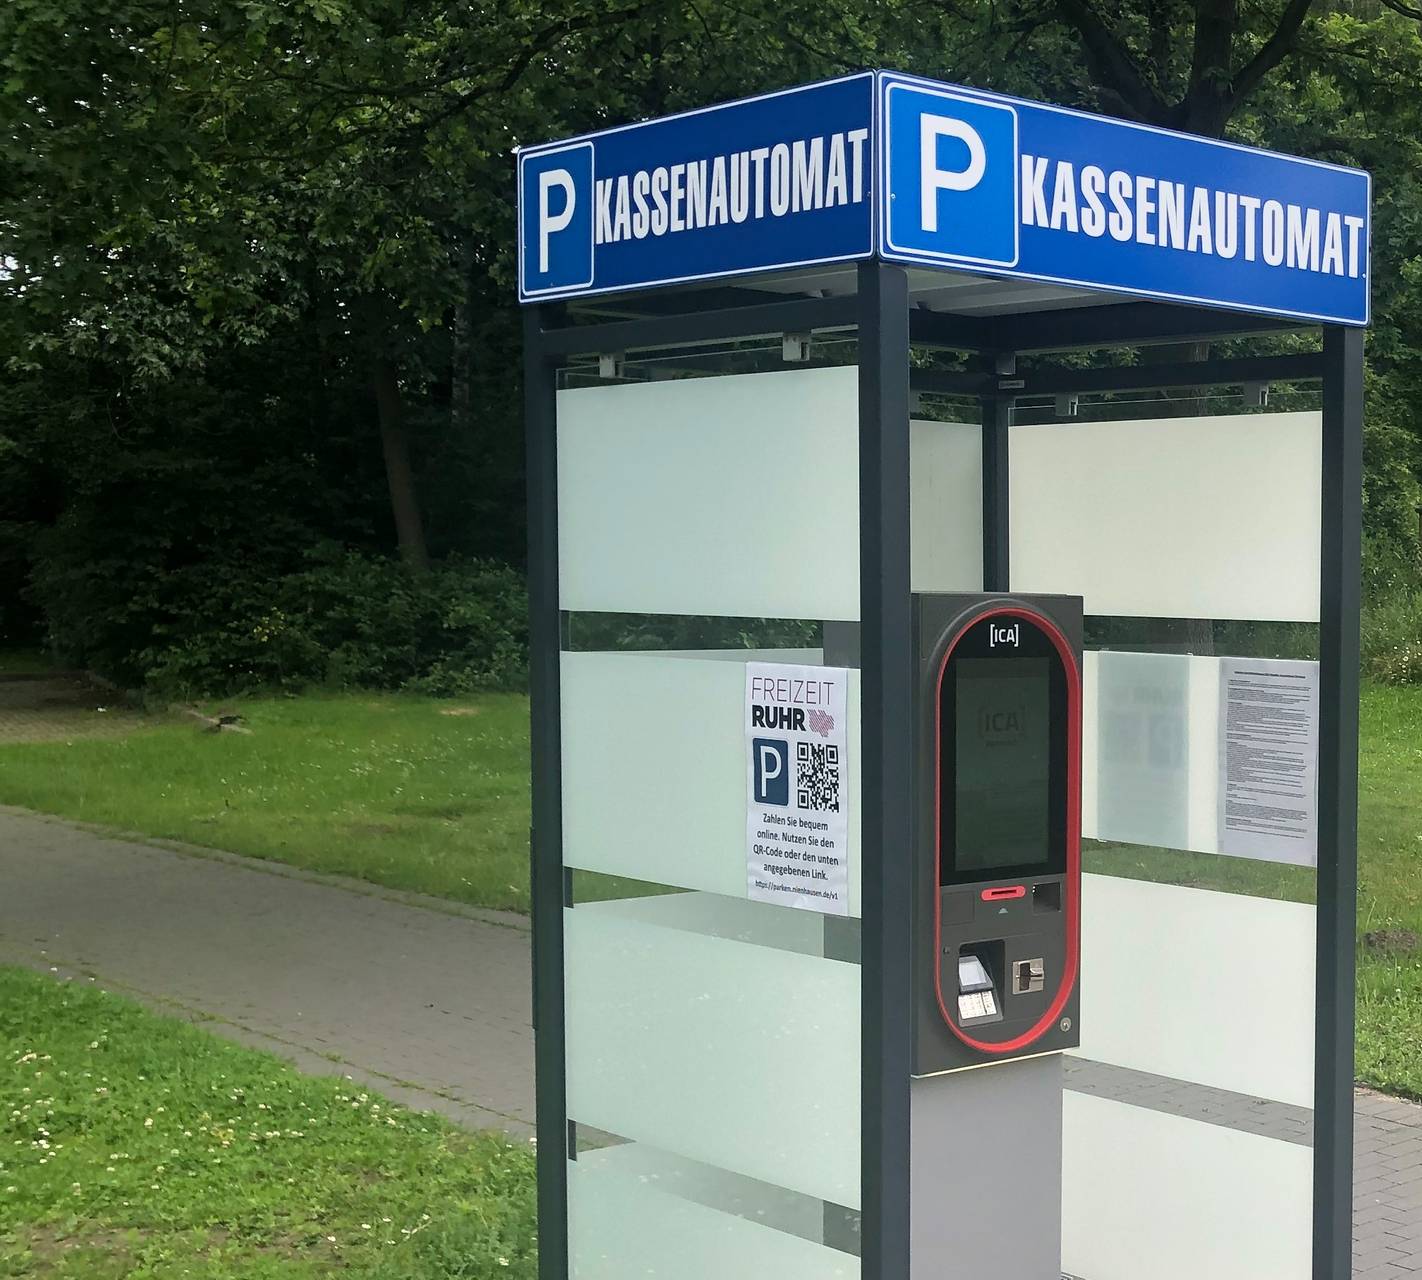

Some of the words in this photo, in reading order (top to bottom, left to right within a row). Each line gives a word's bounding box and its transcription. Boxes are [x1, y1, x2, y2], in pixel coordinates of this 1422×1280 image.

[594, 128, 868, 245] KASSENAUTOMAT
[920, 112, 986, 233] P
[538, 168, 576, 274] P
[1021, 156, 1364, 279] KASSENAUTOMAT
[751, 677, 835, 705] FREIZEIT
[752, 704, 807, 732] RUHR
[760, 745, 782, 797] P
[763, 813, 786, 825] Zahlen
[787, 816, 797, 827] Sie
[799, 818, 828, 831] bequem
[757, 829, 780, 841] online.
[782, 832, 807, 844] Nutzen
[808, 835, 819, 846] Sie
[820, 837, 835, 848] den
[753, 844, 783, 857] QR-Code
[784, 849, 801, 860] oder
[802, 851, 816, 862] den
[818, 855, 839, 866] unten
[763, 863, 810, 877] angegebenen
[812, 869, 828, 880] Link.
